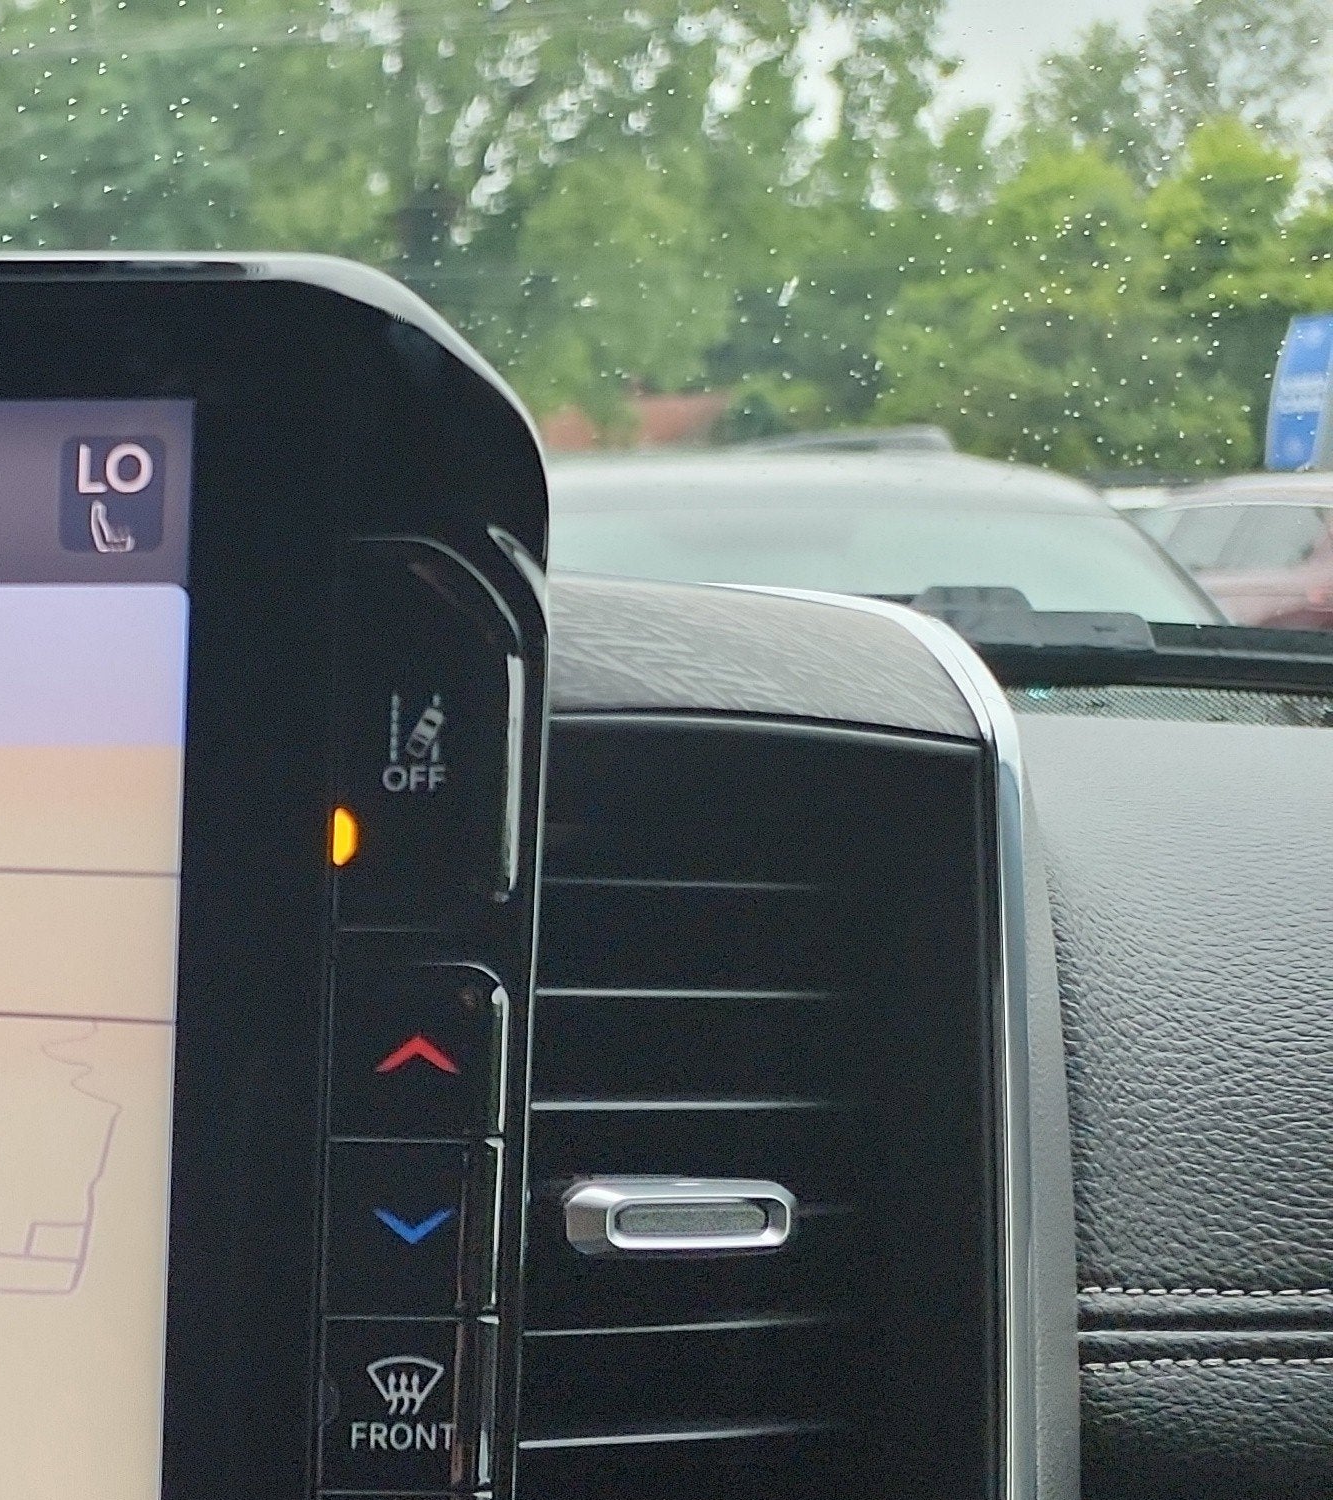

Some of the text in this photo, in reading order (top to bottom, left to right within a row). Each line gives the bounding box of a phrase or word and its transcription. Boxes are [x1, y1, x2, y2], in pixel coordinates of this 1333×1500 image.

[77, 442, 154, 495] LO
[383, 765, 445, 791] OFF
[350, 1422, 455, 1450] FRONT
